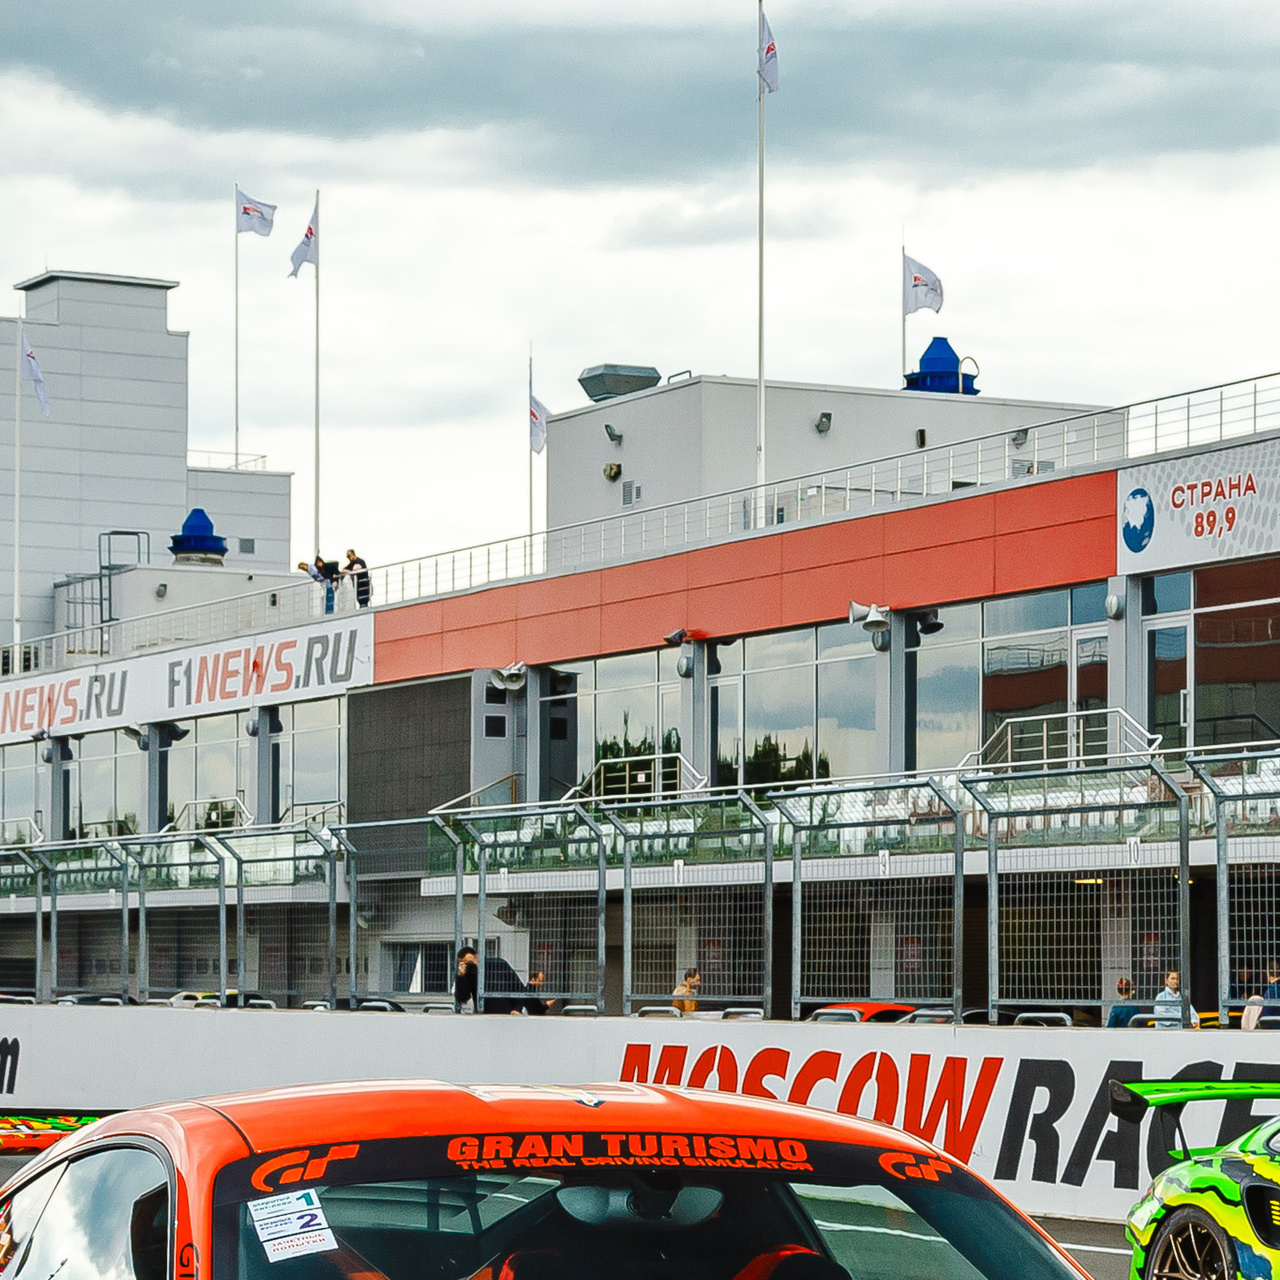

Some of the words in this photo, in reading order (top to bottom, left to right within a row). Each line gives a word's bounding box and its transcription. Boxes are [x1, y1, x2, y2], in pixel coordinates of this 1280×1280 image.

[1171, 474, 1256, 508] СТРАНА
[1194, 507, 1236, 538] 89,9
[168, 630, 357, 708] F1NEWS.RU
[448, 1134, 583, 1161] GRAN
[601, 1134, 808, 1162] TURISMO
[456, 1159, 507, 1170] THE
[515, 1157, 576, 1168] REAL
[581, 1156, 683, 1166] DRIVING
[686, 1157, 815, 1172] SIMULATOR
[296, 1192, 314, 1206] 1
[296, 1213, 322, 1230] 2
